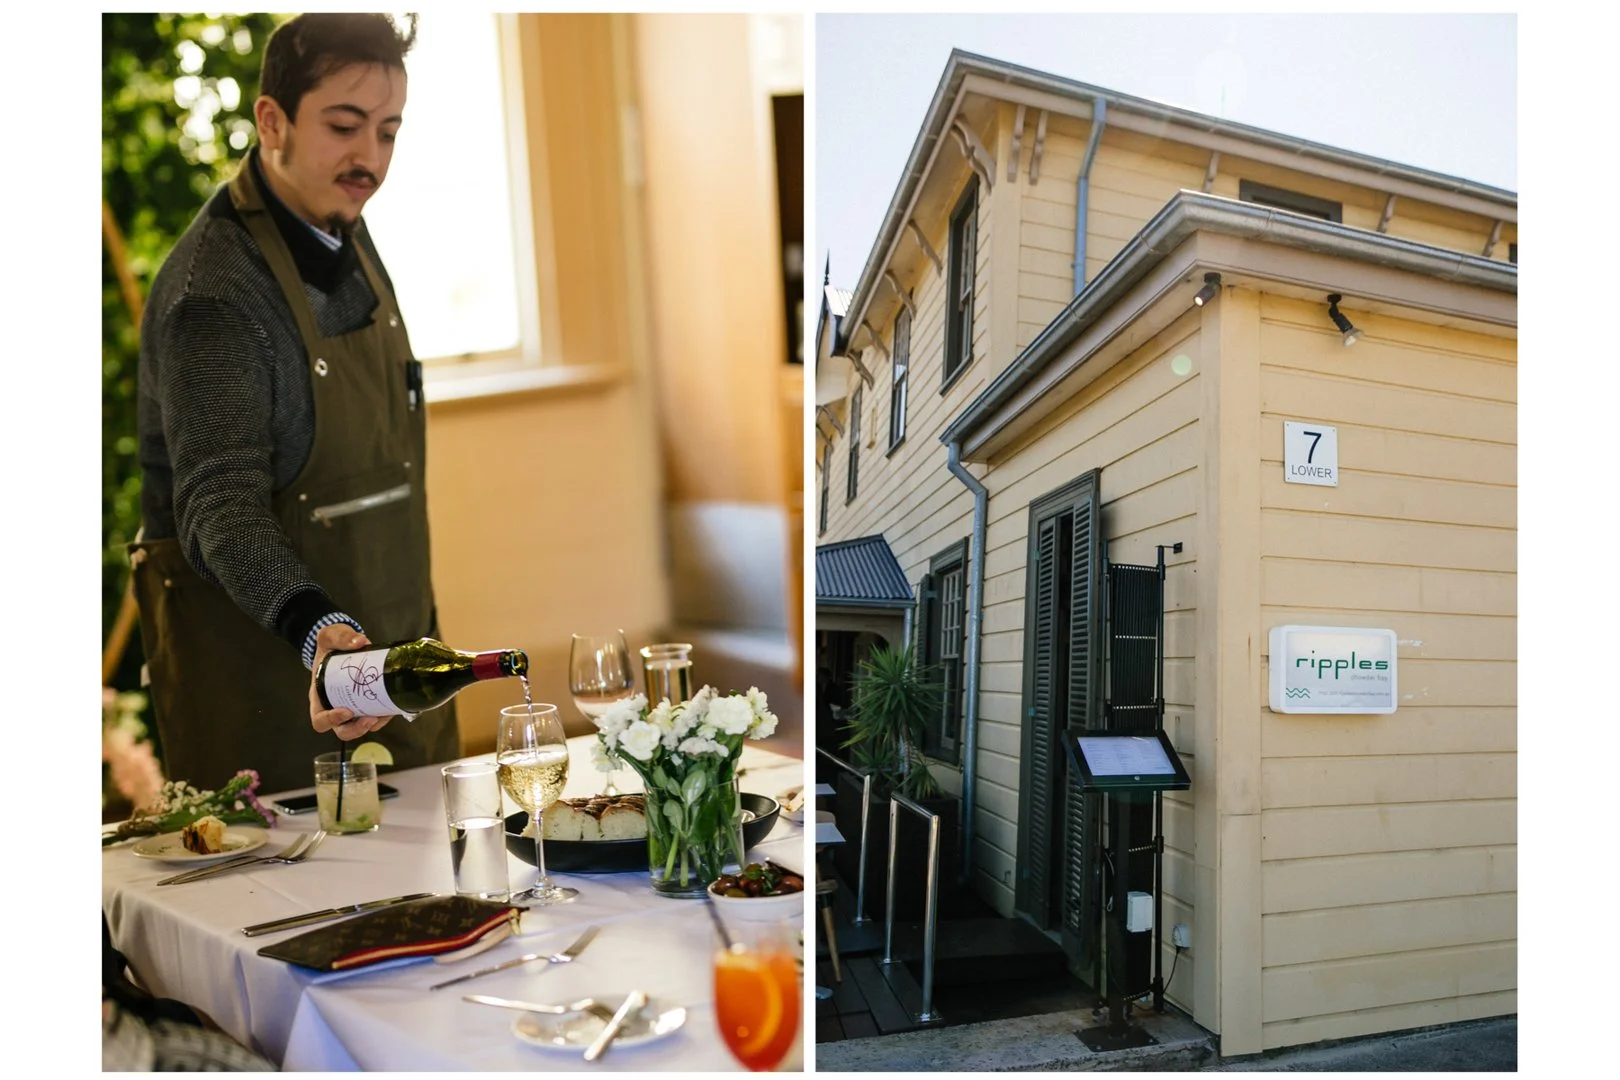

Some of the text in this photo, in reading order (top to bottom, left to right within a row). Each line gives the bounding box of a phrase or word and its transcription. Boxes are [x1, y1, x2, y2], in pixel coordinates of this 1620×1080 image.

[1303, 431, 1322, 464] 7
[1291, 465, 1333, 479] LOWER
[1296, 650, 1389, 680] ripples
